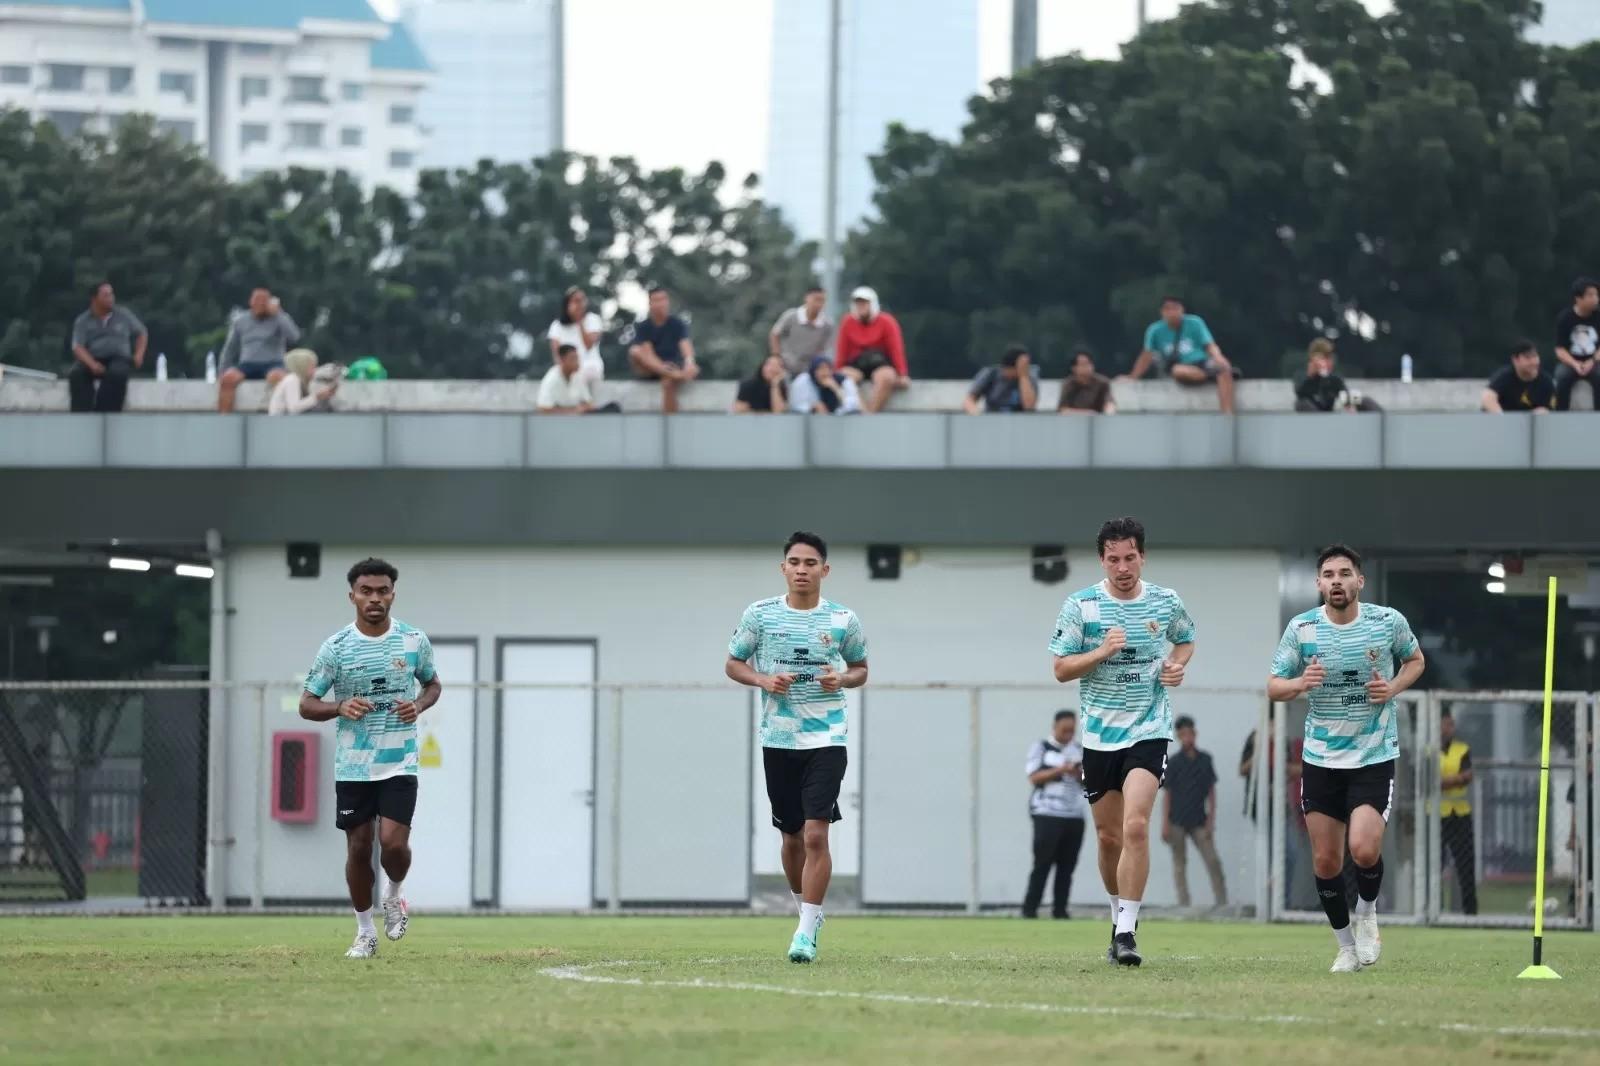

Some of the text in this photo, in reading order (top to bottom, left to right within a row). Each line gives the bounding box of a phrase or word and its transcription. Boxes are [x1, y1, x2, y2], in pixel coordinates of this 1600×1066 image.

[799, 674, 814, 683] BRI
[1124, 673, 1140, 683] BRI
[1351, 695, 1367, 704] BRI
